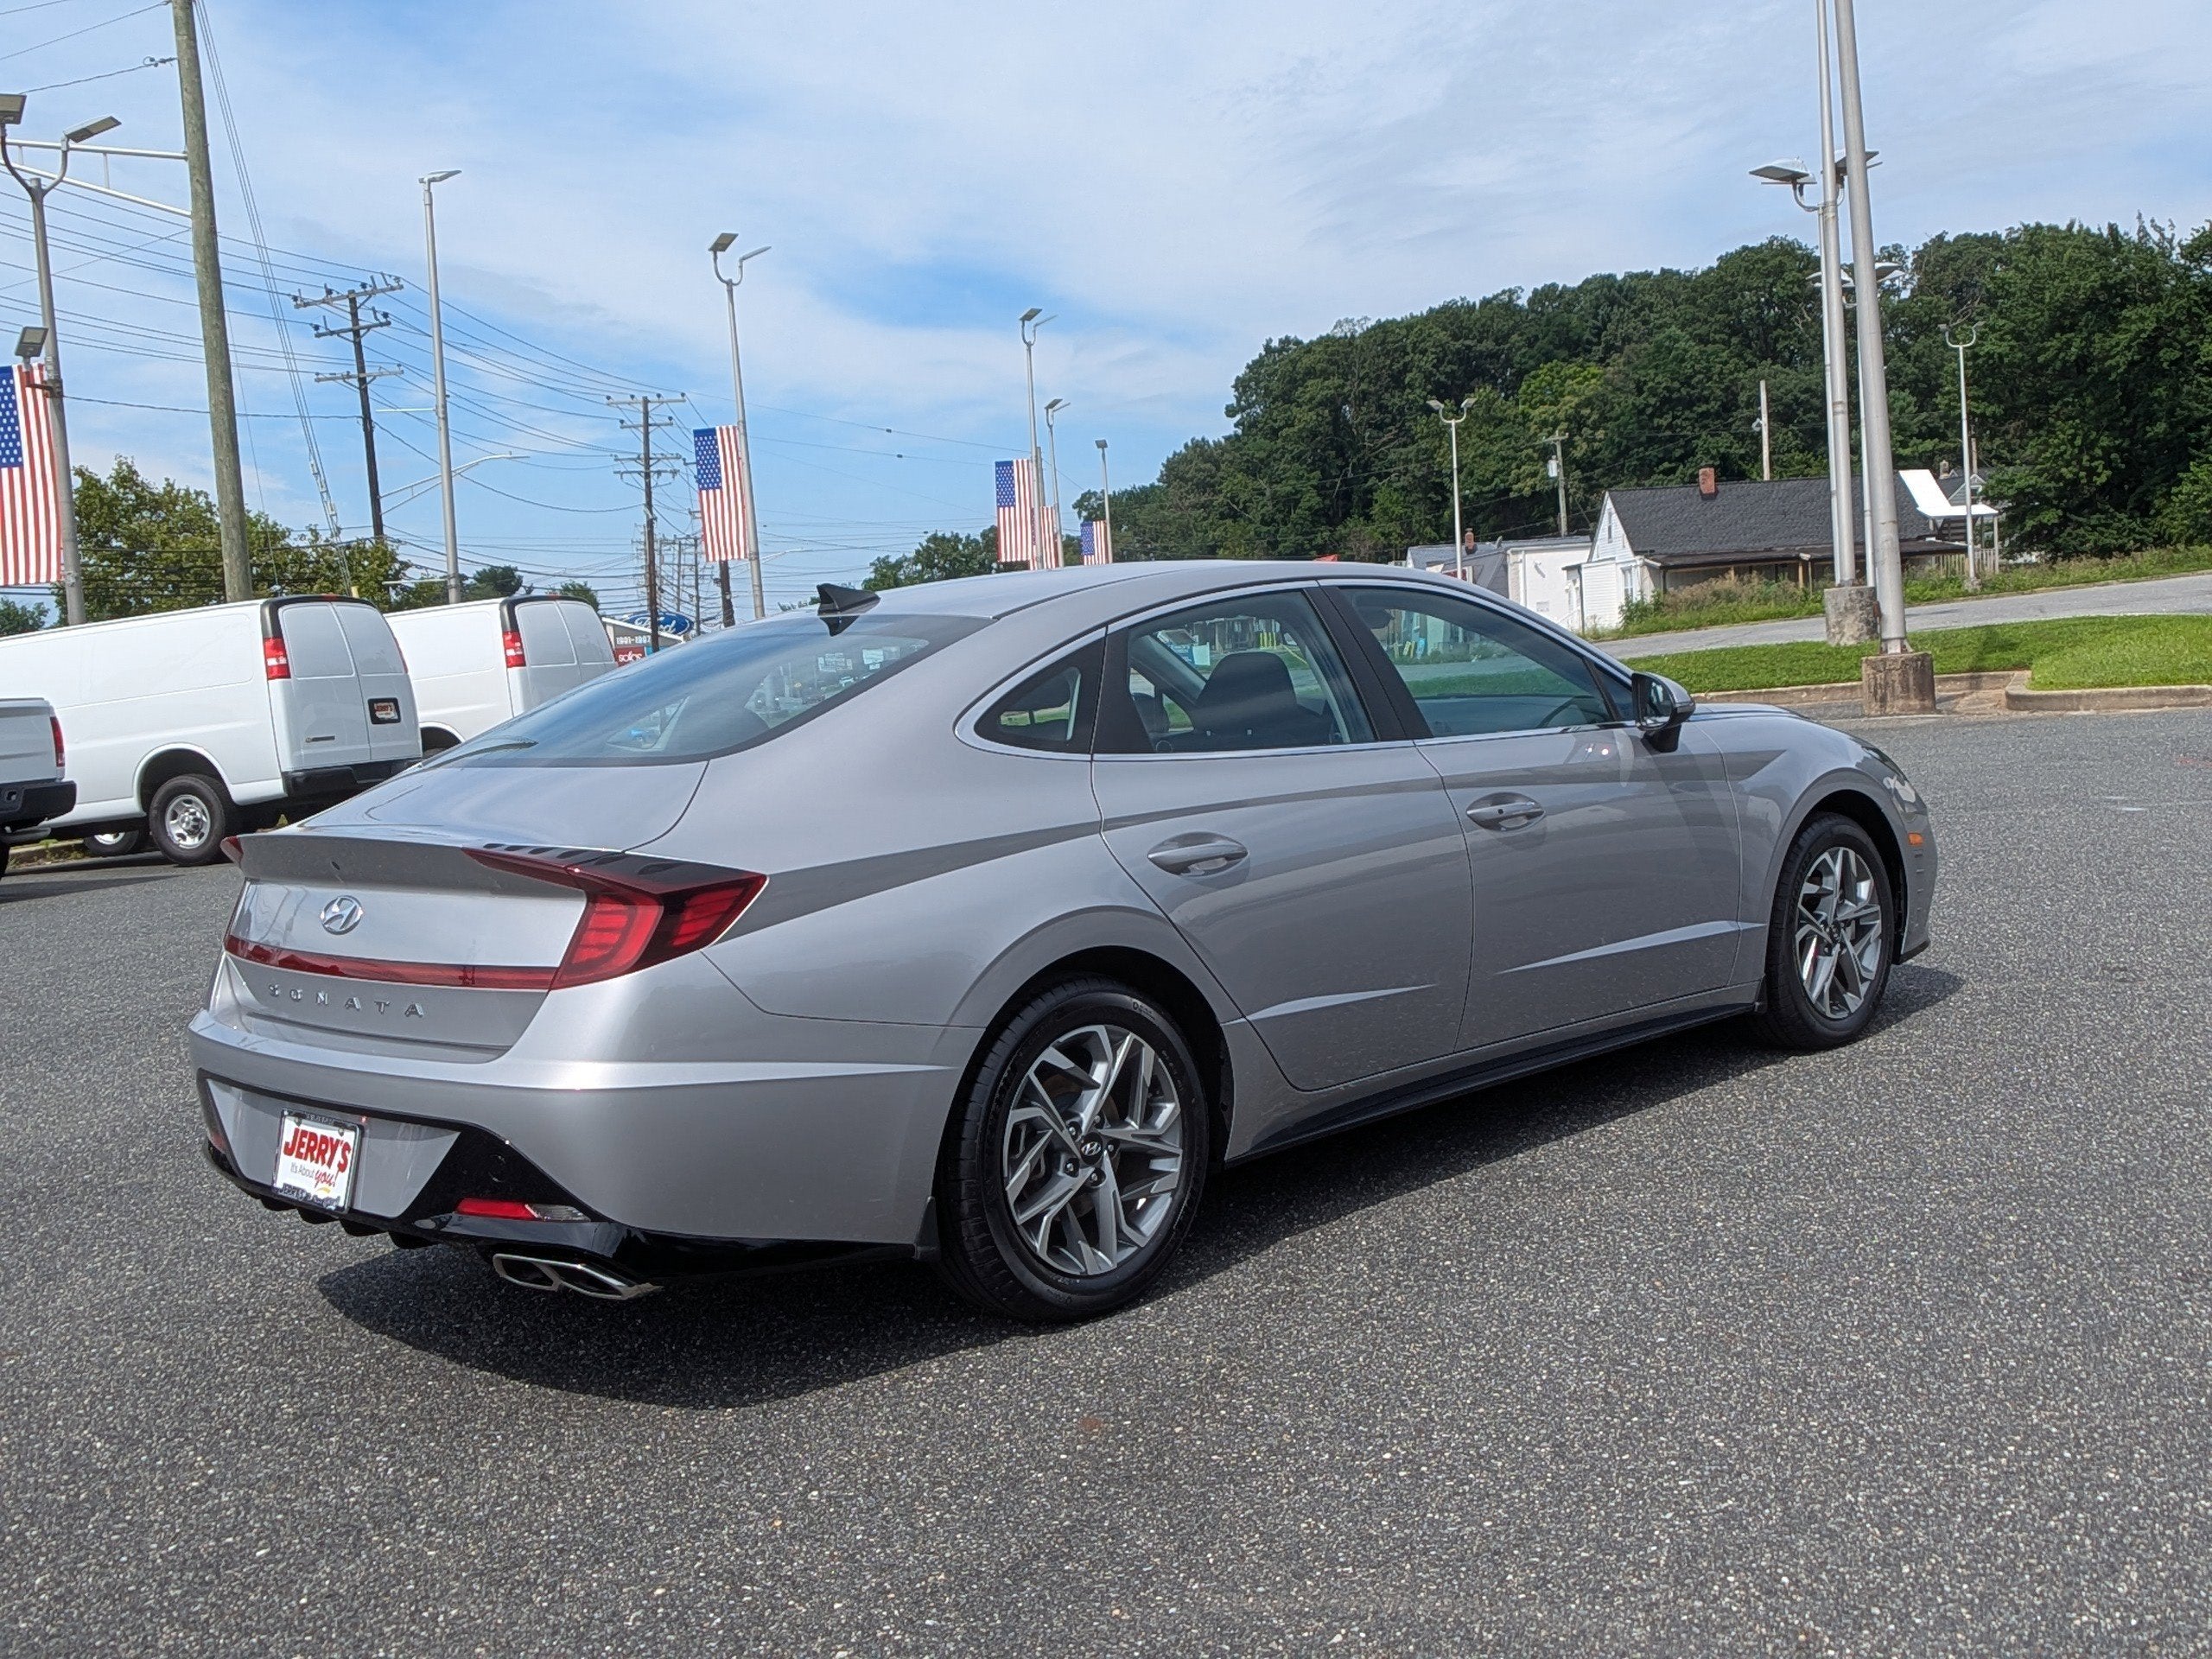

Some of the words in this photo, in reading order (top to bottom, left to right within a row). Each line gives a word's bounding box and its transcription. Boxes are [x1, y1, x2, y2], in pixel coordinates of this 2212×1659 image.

[268, 983, 424, 1018] SONATA
[283, 1127, 352, 1173] JERRY'S
[298, 1164, 315, 1179] About
[315, 1169, 338, 1188] you!
